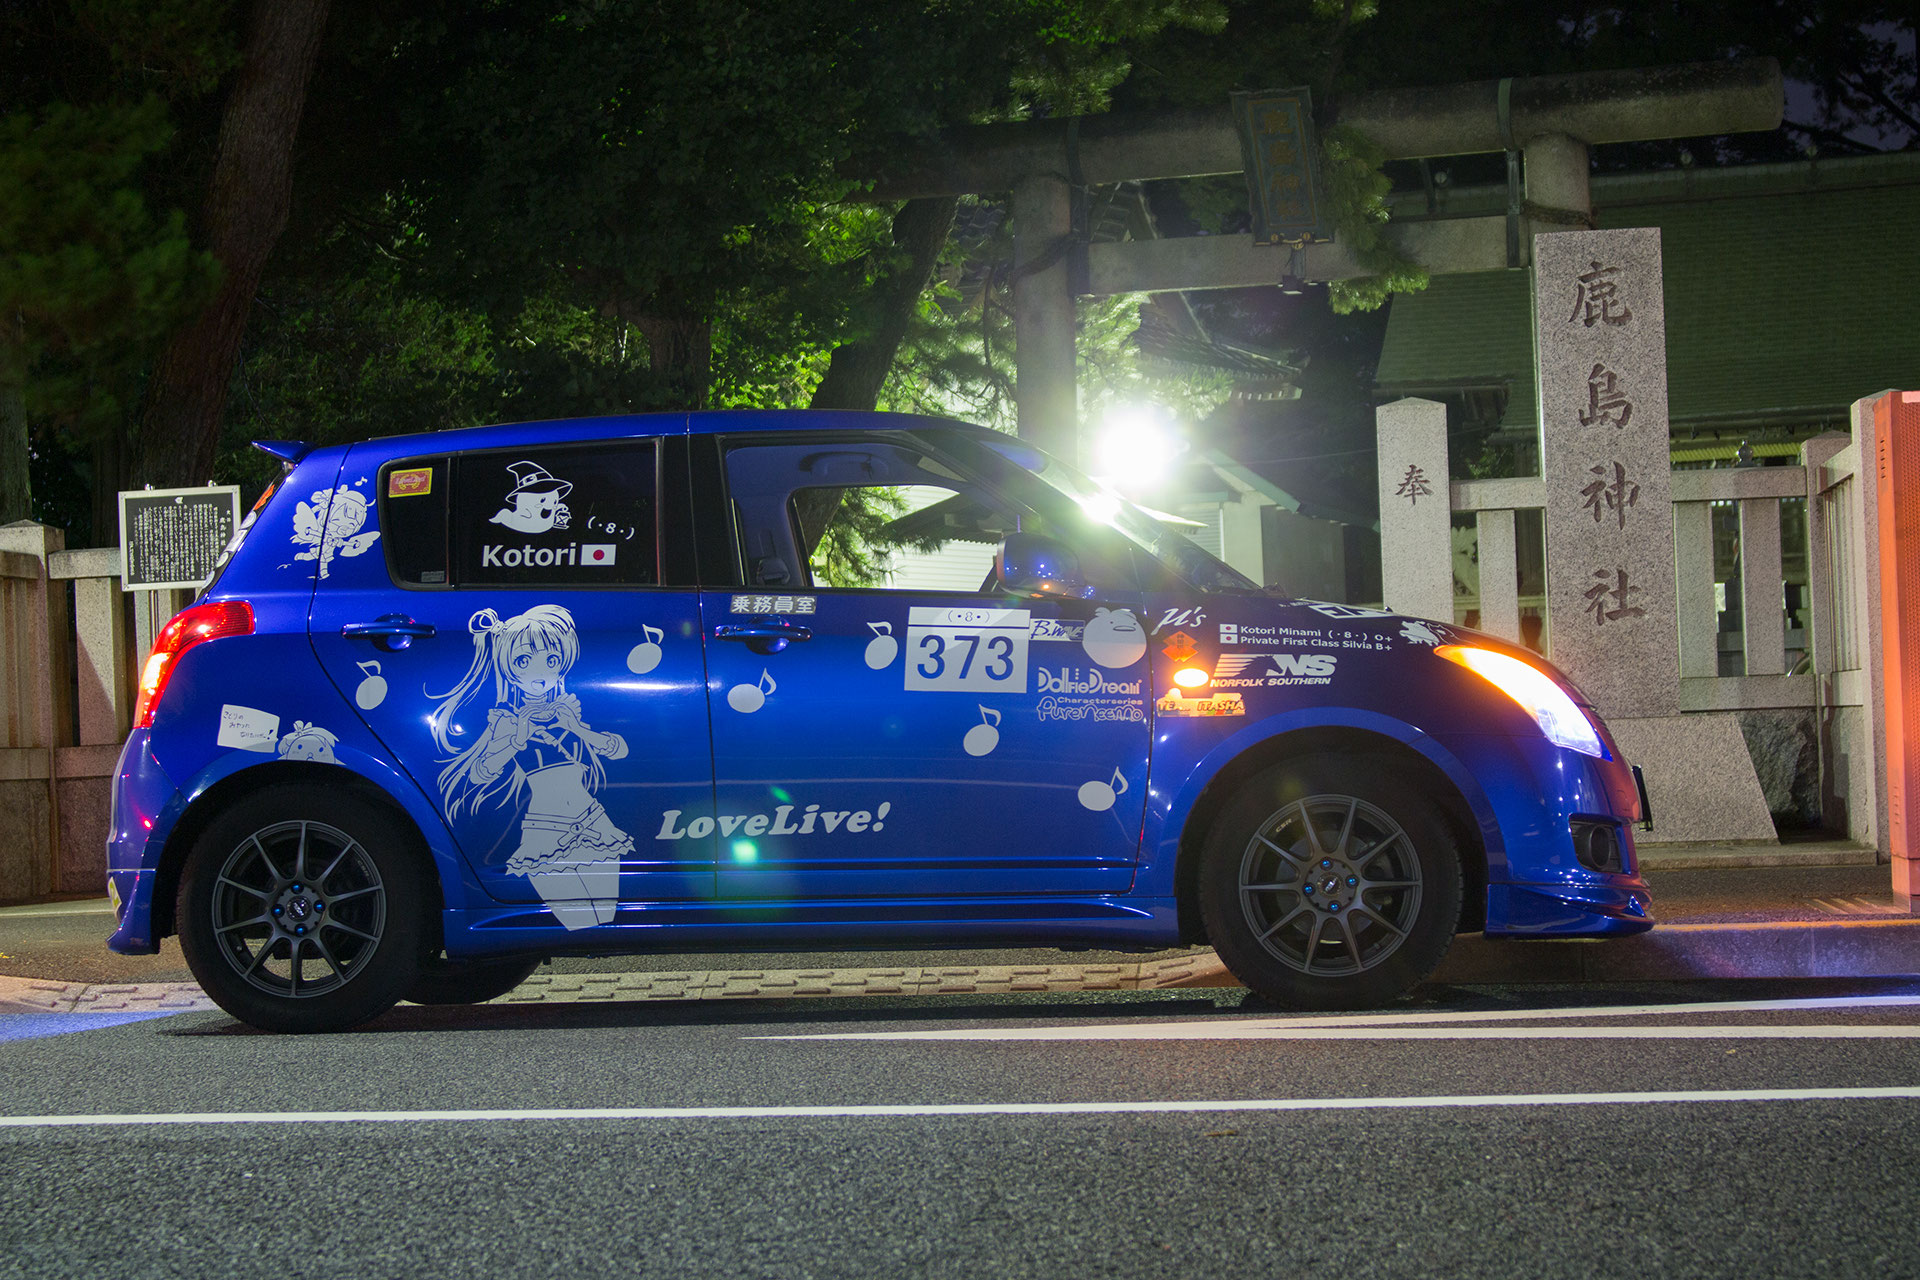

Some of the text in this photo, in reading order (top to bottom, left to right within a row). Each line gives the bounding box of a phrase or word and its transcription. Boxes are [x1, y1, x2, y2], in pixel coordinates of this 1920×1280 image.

[1568, 259, 1646, 626] 鹿島神社
[1395, 463, 1434, 506] 奉
[481, 542, 577, 568] Kotori
[731, 595, 816, 614] 乗務員室
[1240, 626, 1276, 635] Kotori
[1279, 627, 1321, 637] Minami
[1240, 636, 1392, 651] Private First Class Silvia B+
[916, 634, 1014, 681] 373
[1209, 677, 1331, 688] NORFOLK SOUTHERN
[1196, 700, 1245, 711] ITASHA
[655, 801, 892, 840] LoveLive!
